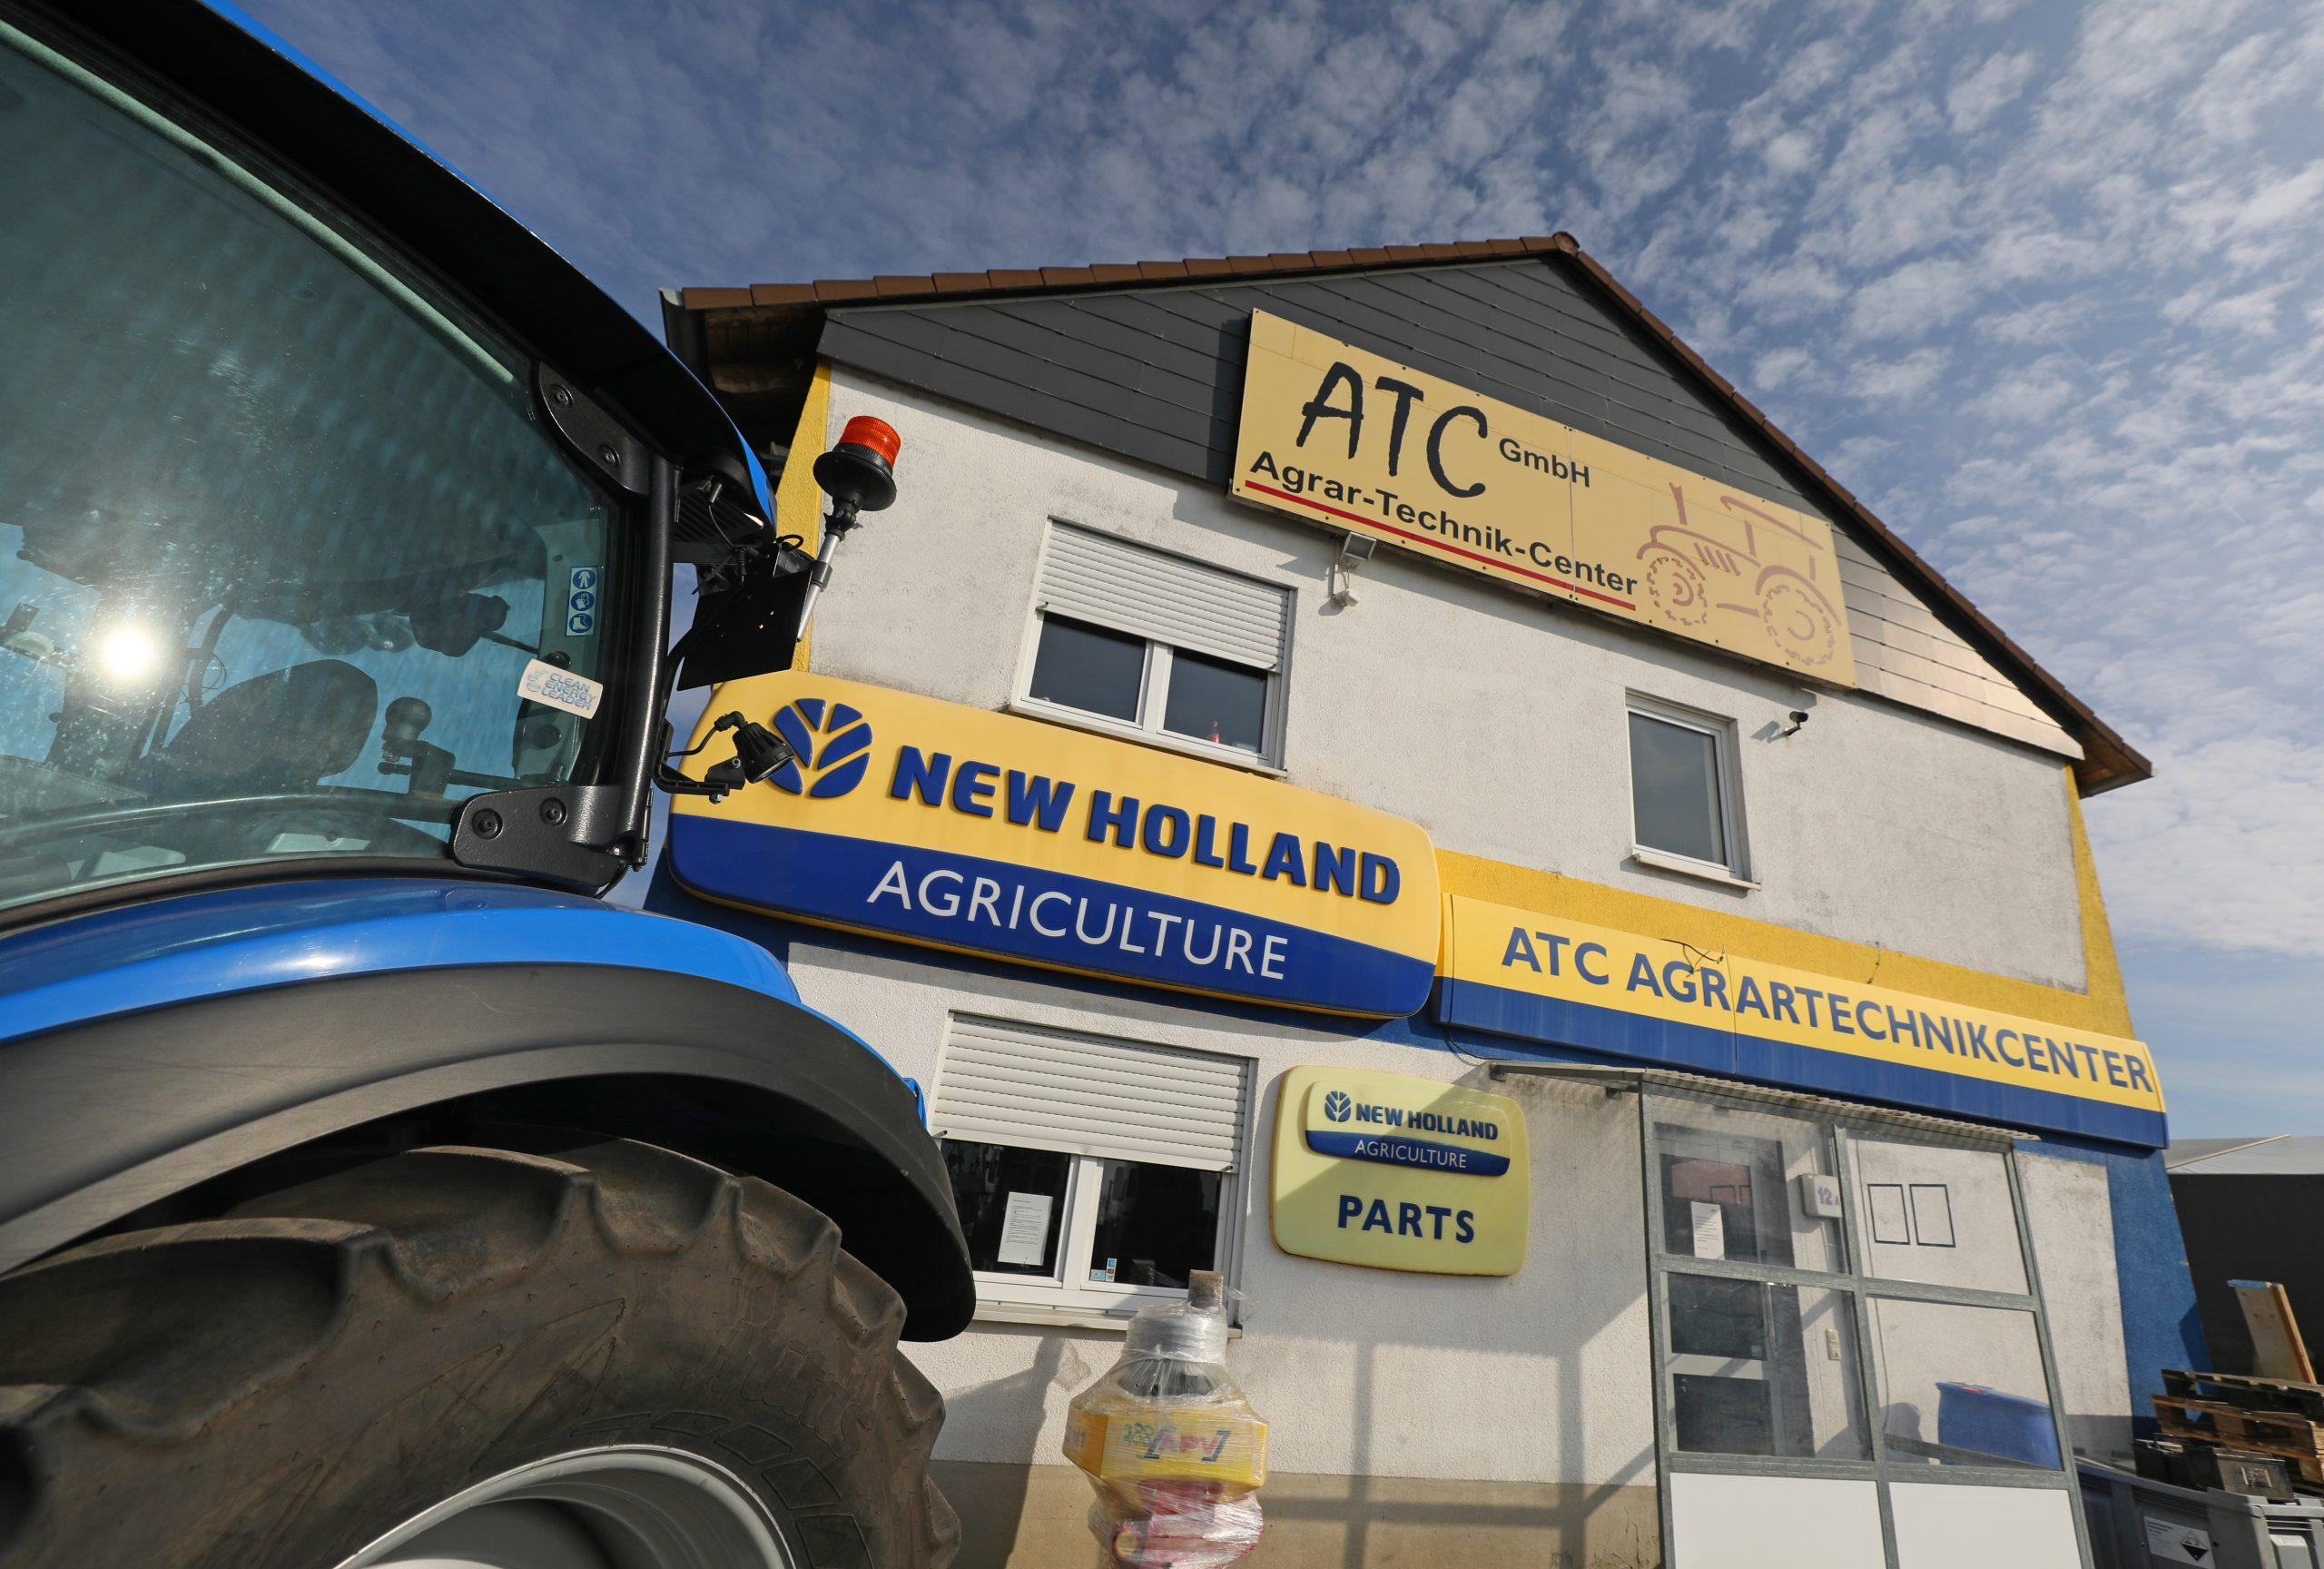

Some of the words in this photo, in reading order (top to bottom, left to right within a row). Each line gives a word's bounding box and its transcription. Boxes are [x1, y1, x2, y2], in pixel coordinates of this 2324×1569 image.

[1296, 360, 1488, 498] ATC
[1499, 438, 1591, 488] GmbH
[1249, 451, 1638, 596] Agrar-Technik-Center
[541, 687, 591, 710] LEADER
[545, 680, 596, 702] ENERGY
[550, 673, 590, 692] CLEAN
[891, 744, 1076, 833] NEW
[1088, 789, 1401, 905] HOLLAND
[866, 860, 1289, 980] AGRICULTURE
[1501, 925, 1610, 986] ATC
[1625, 952, 2154, 1093] AGRARTECHNIKCENTER
[1355, 1102, 1403, 1127] NEW
[1408, 1110, 1499, 1140] HOLLAND
[1354, 1139, 1467, 1169] AGRICULTURE
[1337, 1194, 1475, 1243] PARTS
